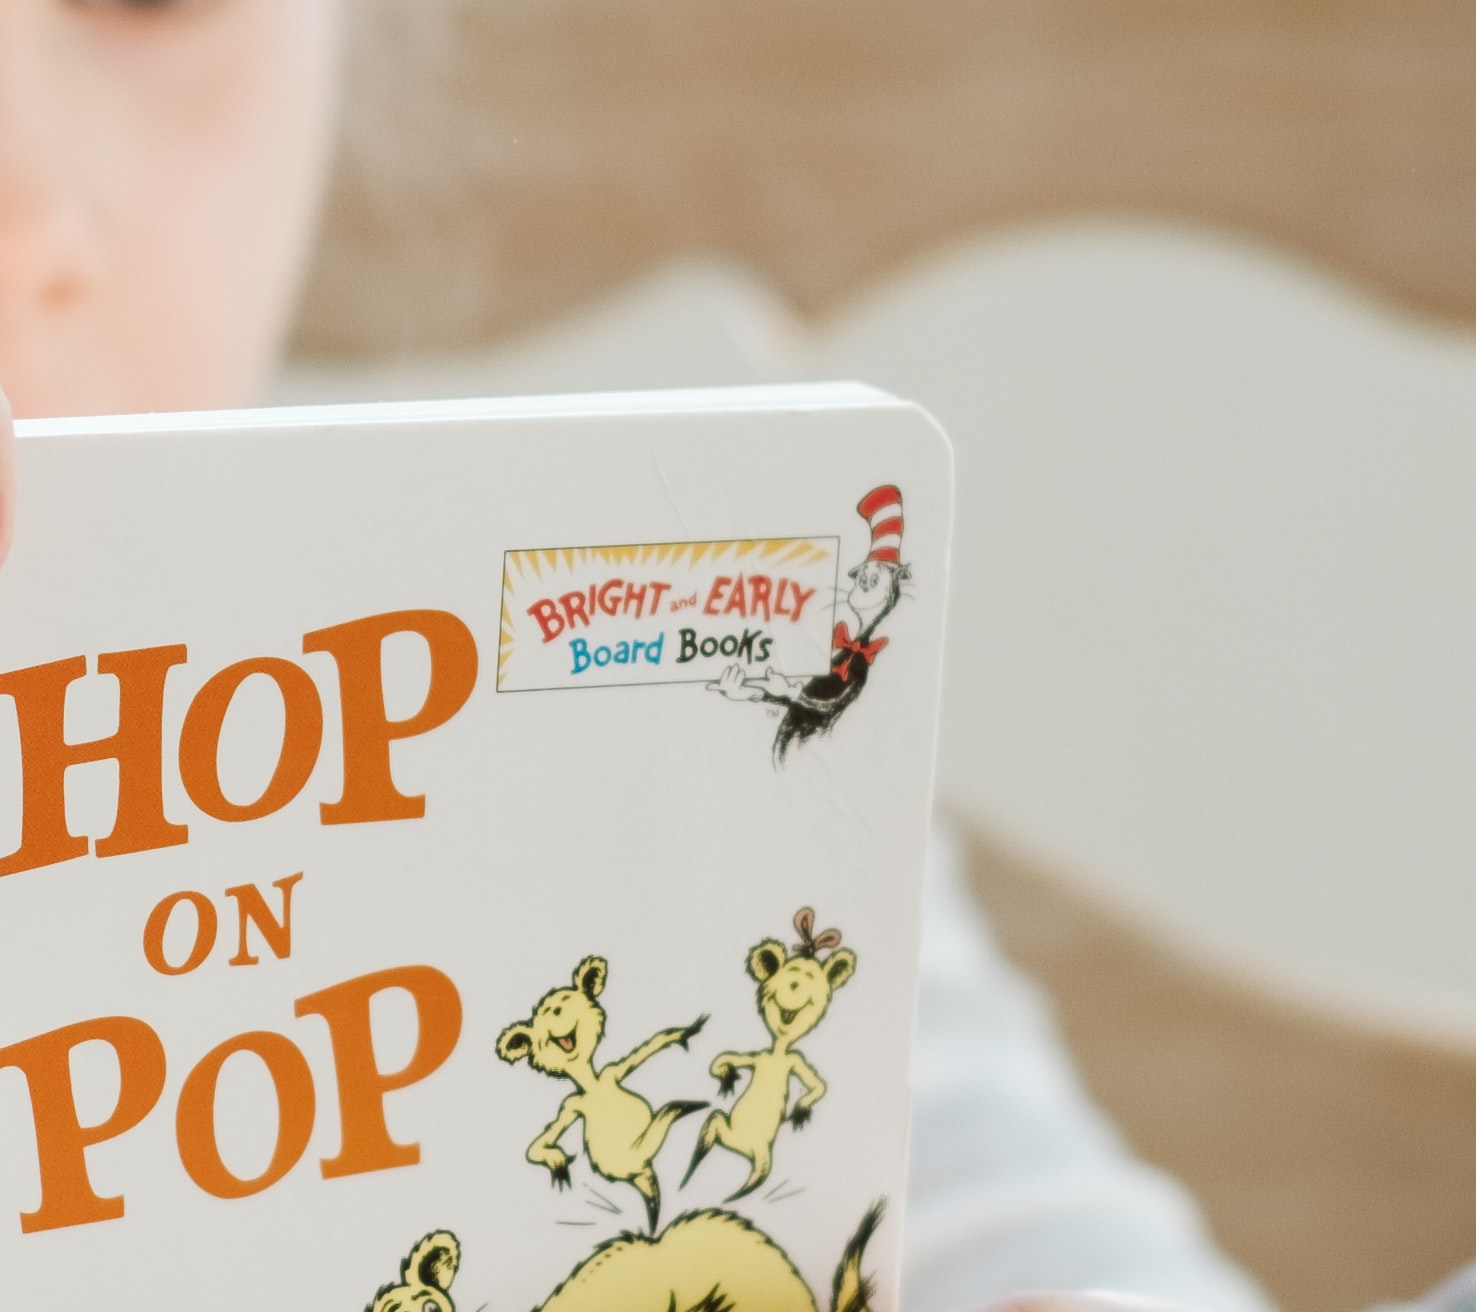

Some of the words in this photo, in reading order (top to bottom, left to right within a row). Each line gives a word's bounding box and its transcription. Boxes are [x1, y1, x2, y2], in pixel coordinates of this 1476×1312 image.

[527, 577, 672, 644] BRIGHT
[669, 592, 698, 613] and
[702, 572, 816, 623] EARLY
[568, 632, 664, 675] Board
[144, 873, 303, 976] ON
